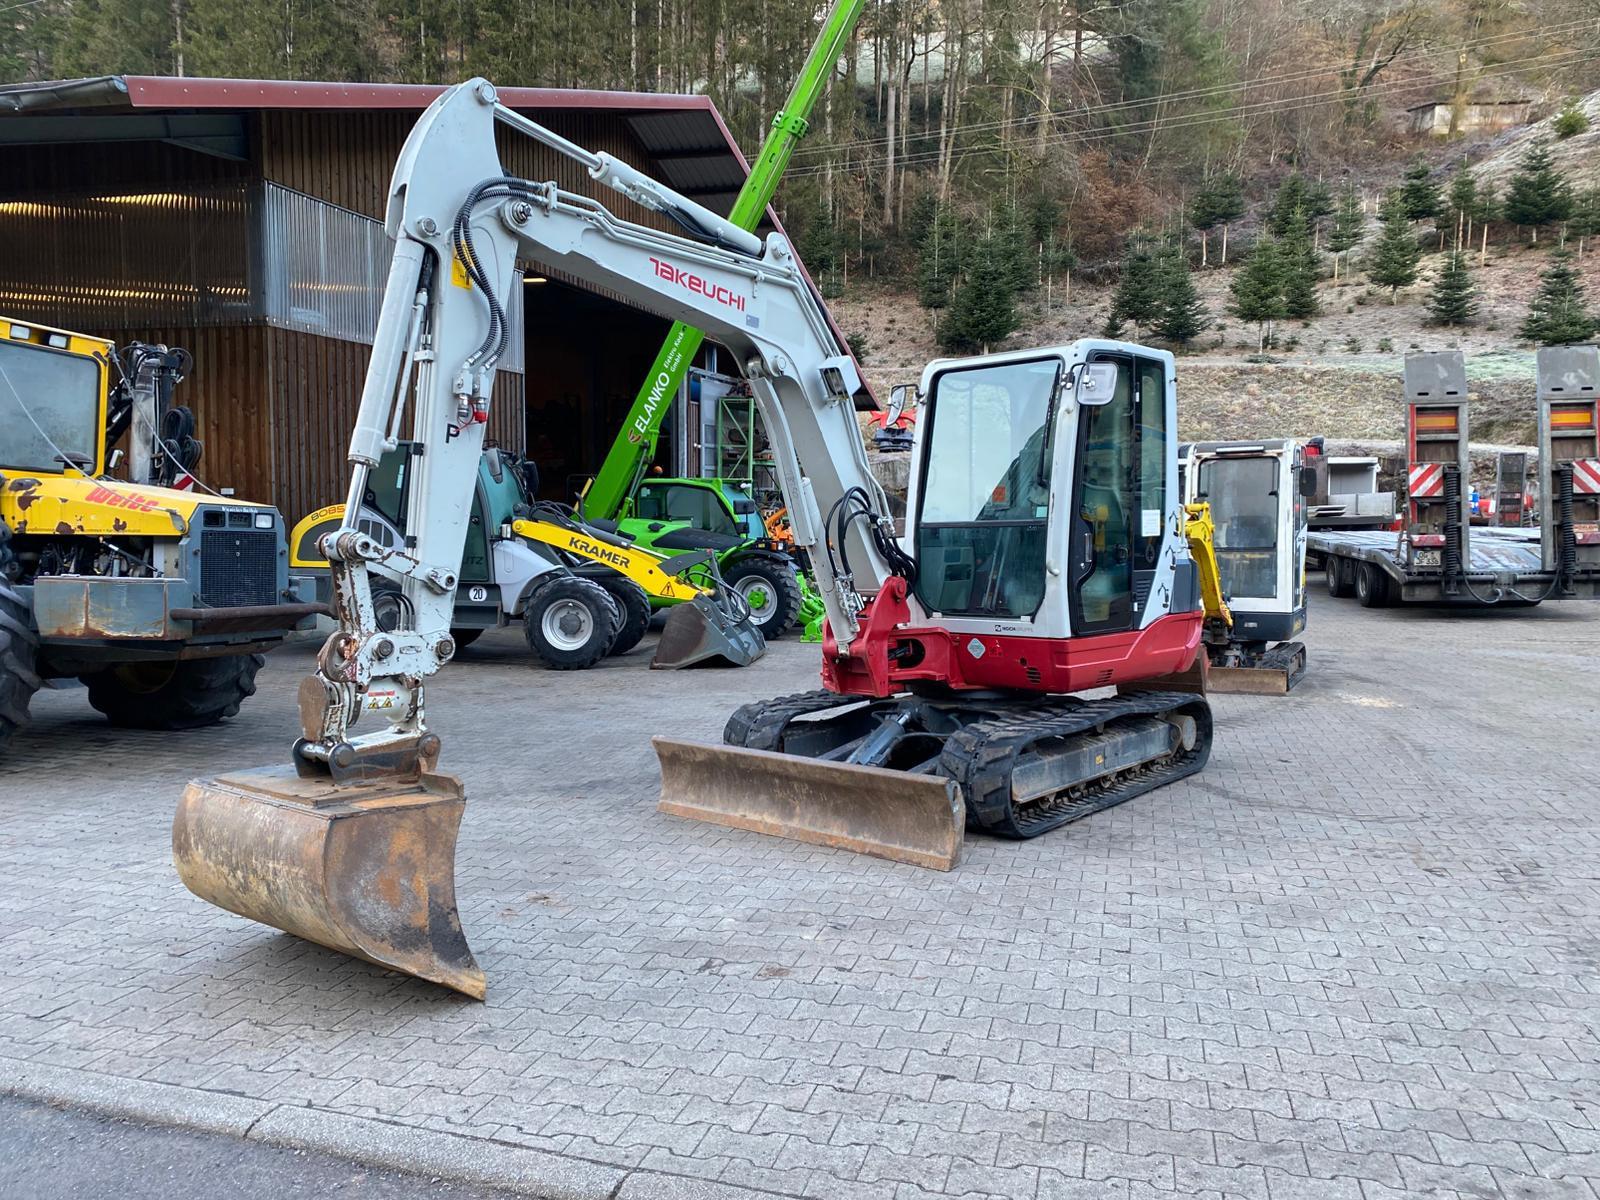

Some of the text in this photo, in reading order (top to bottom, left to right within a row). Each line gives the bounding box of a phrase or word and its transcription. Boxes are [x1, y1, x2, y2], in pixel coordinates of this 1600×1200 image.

[634, 371, 671, 434] ELANKO
[445, 422, 460, 444] P
[568, 536, 632, 570] KRAMER
[473, 588, 483, 600] 20
